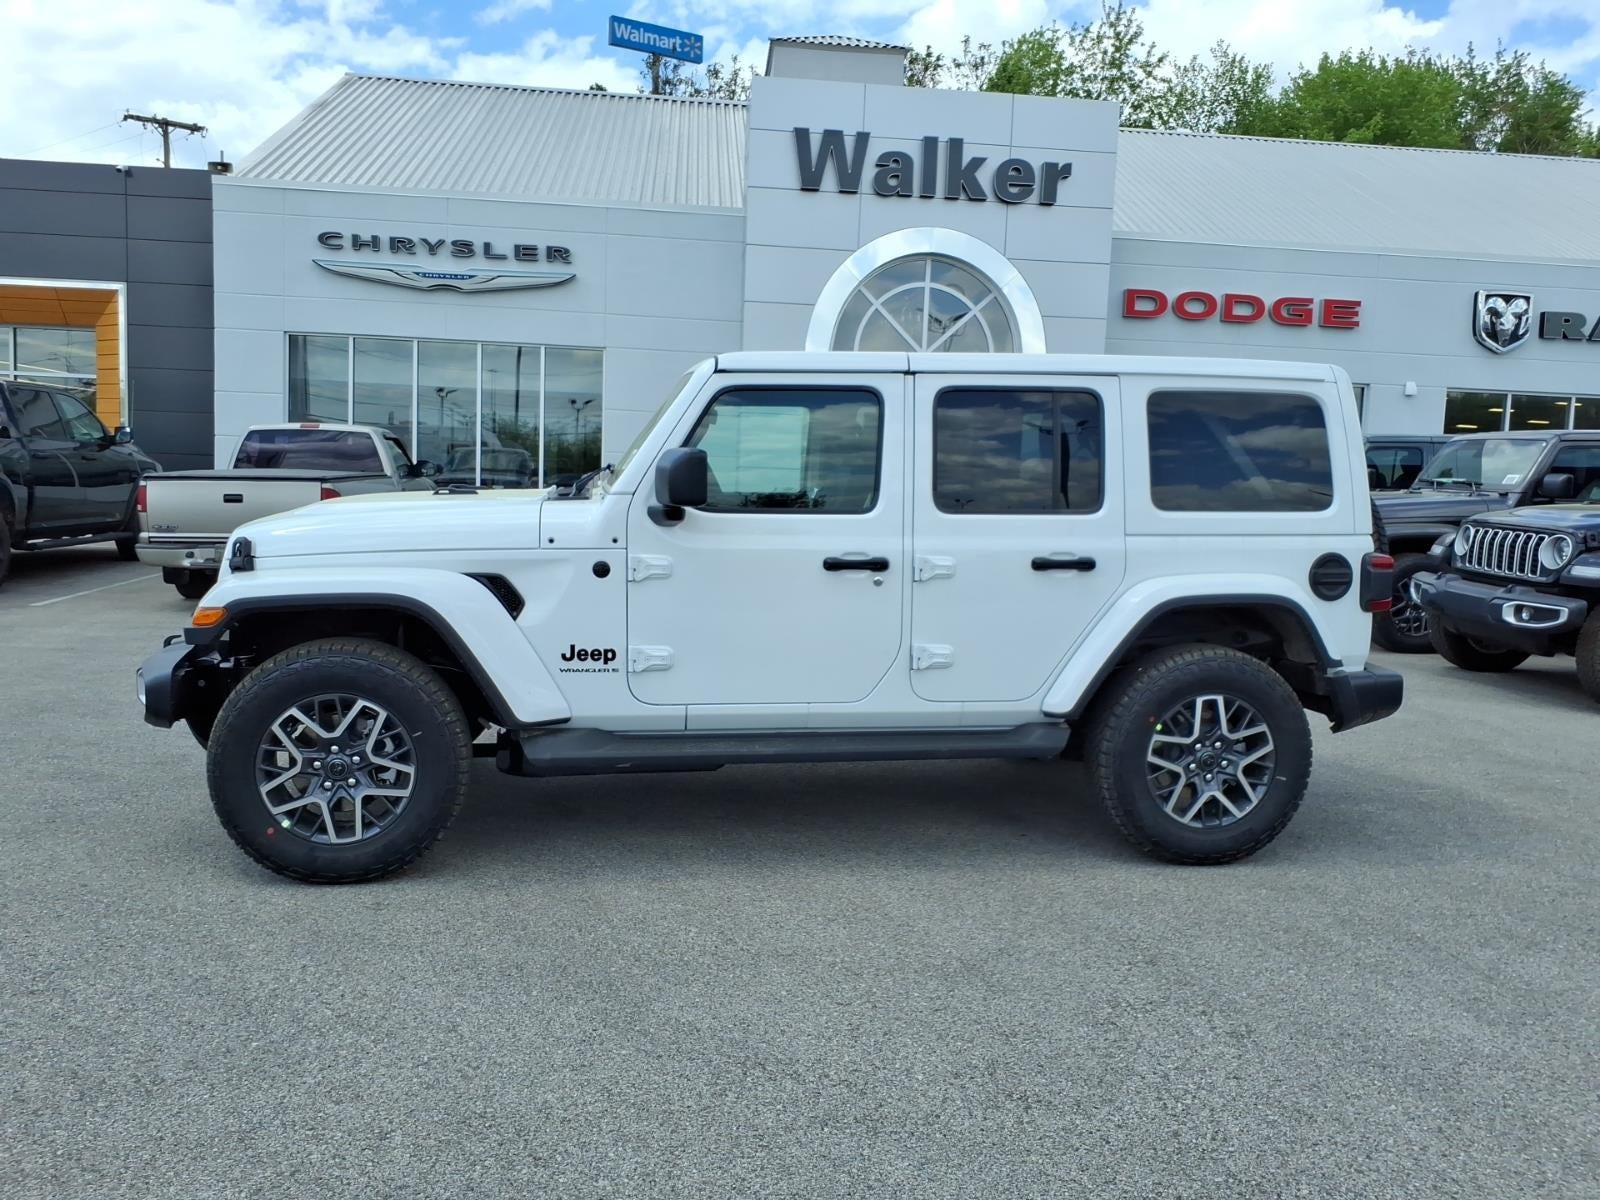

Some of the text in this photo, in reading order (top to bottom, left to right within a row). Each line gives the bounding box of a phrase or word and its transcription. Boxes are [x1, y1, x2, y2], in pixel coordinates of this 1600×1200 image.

[614, 22, 682, 52] Walmart
[793, 127, 1072, 206] Walker
[317, 231, 572, 263] CHRYSLER
[1123, 288, 1362, 328] DODGE
[561, 644, 617, 665] Jeep
